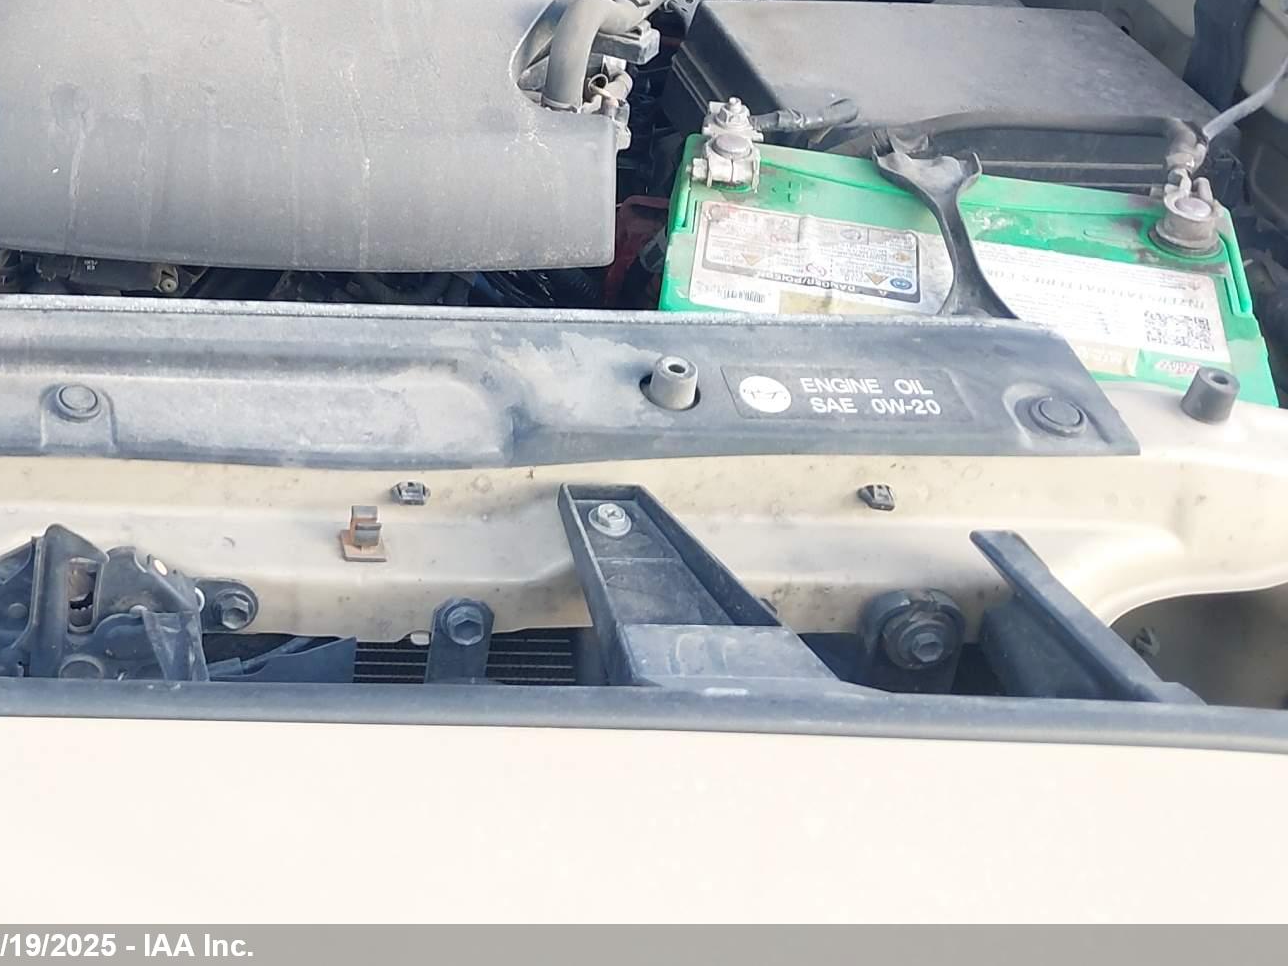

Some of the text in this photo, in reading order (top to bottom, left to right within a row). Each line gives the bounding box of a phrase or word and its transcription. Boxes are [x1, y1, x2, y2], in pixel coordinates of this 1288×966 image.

[799, 377, 934, 395] ENGINE OIL
[810, 397, 942, 415] SAE 0W-20
